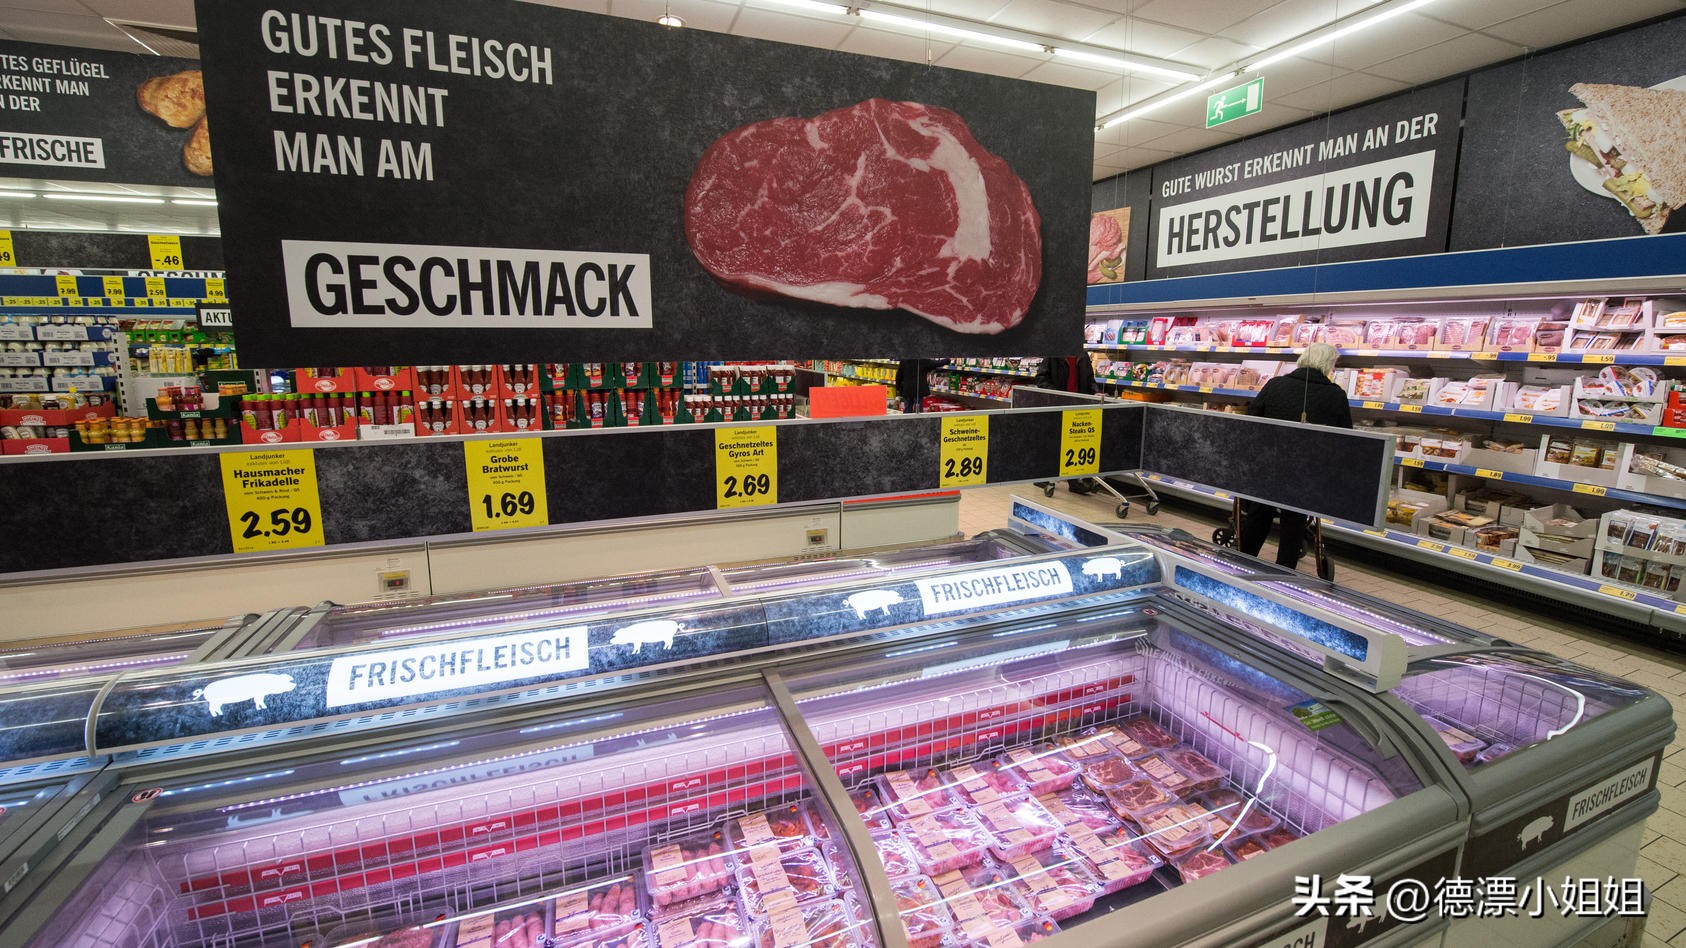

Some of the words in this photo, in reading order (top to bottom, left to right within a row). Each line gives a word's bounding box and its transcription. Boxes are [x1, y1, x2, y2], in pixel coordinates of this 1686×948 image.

[261, 9, 392, 66] GUTES
[403, 26, 554, 85] FLEISCH
[32, 58, 110, 78] GEFLÜGEL
[0, 74, 51, 93] KENNT
[56, 79, 90, 96] MAN
[9, 94, 40, 112] DER
[267, 69, 449, 128] ERKENNT
[0, 136, 97, 164] FRISCHE
[273, 129, 364, 177] MAN
[378, 141, 434, 182] AM
[1162, 175, 1192, 198] GUTE
[1195, 163, 1240, 190] WURST
[1244, 144, 1314, 179] ERKENNT
[1318, 132, 1358, 162] MAN
[1362, 124, 1390, 152] AN
[1395, 112, 1438, 145] DER
[1166, 171, 1414, 256] HERSTELLUNG
[304, 252, 640, 318] GESCHMACK
[719, 440, 773, 450] Geschnetzeltes
[729, 450, 750, 458] Gyros
[1065, 448, 1096, 467] 2.99
[482, 464, 528, 473] Bratwurst
[490, 455, 519, 463] Grobe
[945, 456, 982, 478] 2.89
[234, 467, 305, 479] Hausmacher
[242, 477, 299, 488] Frikadelle
[724, 474, 770, 498] 2.69
[482, 491, 534, 518] 1.69
[240, 507, 311, 539] 2.59
[930, 567, 1062, 603] FRISCHFLEISCH
[349, 636, 570, 691] FRISCHFLEISCH
[1572, 768, 1648, 821] FRISCHFLEISCH
